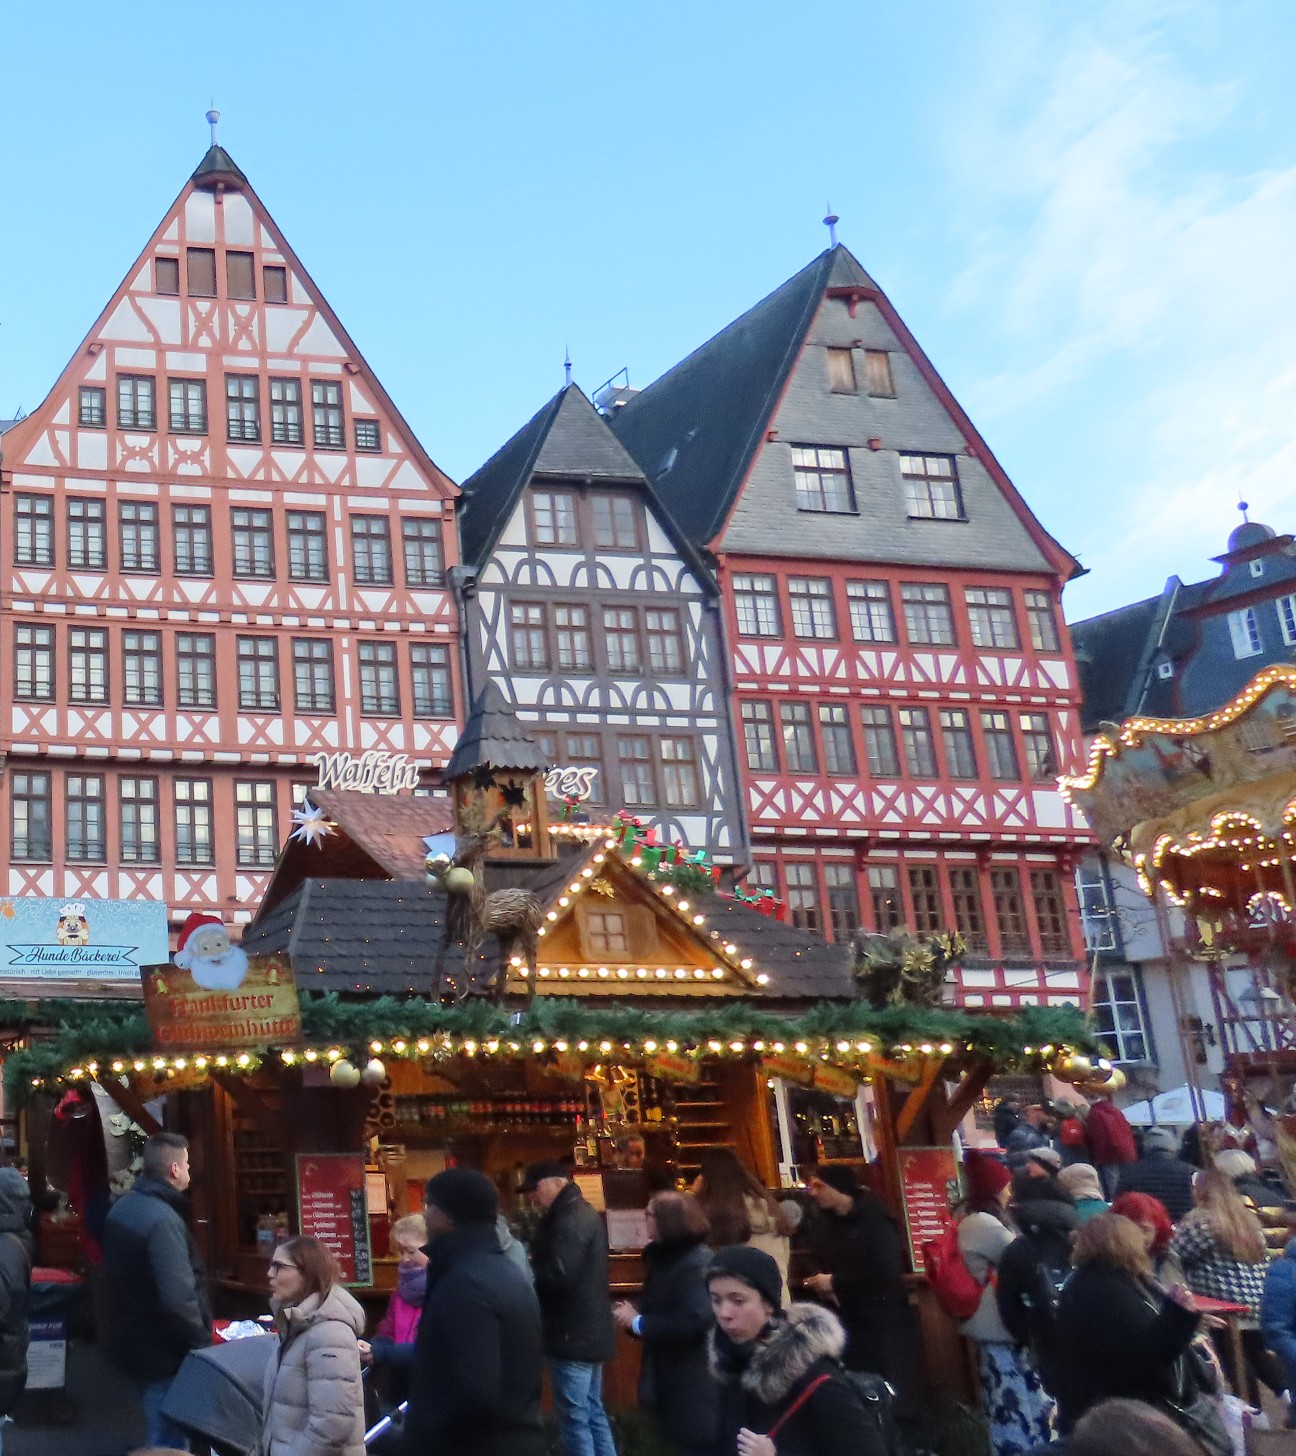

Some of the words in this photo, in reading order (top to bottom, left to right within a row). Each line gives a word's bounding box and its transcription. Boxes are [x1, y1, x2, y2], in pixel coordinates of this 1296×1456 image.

[312, 750, 420, 796] Waffeln
[25, 946, 70, 963] Hunde
[70, 947, 121, 963] Bäckerei
[172, 992, 275, 1016] Frankfurter
